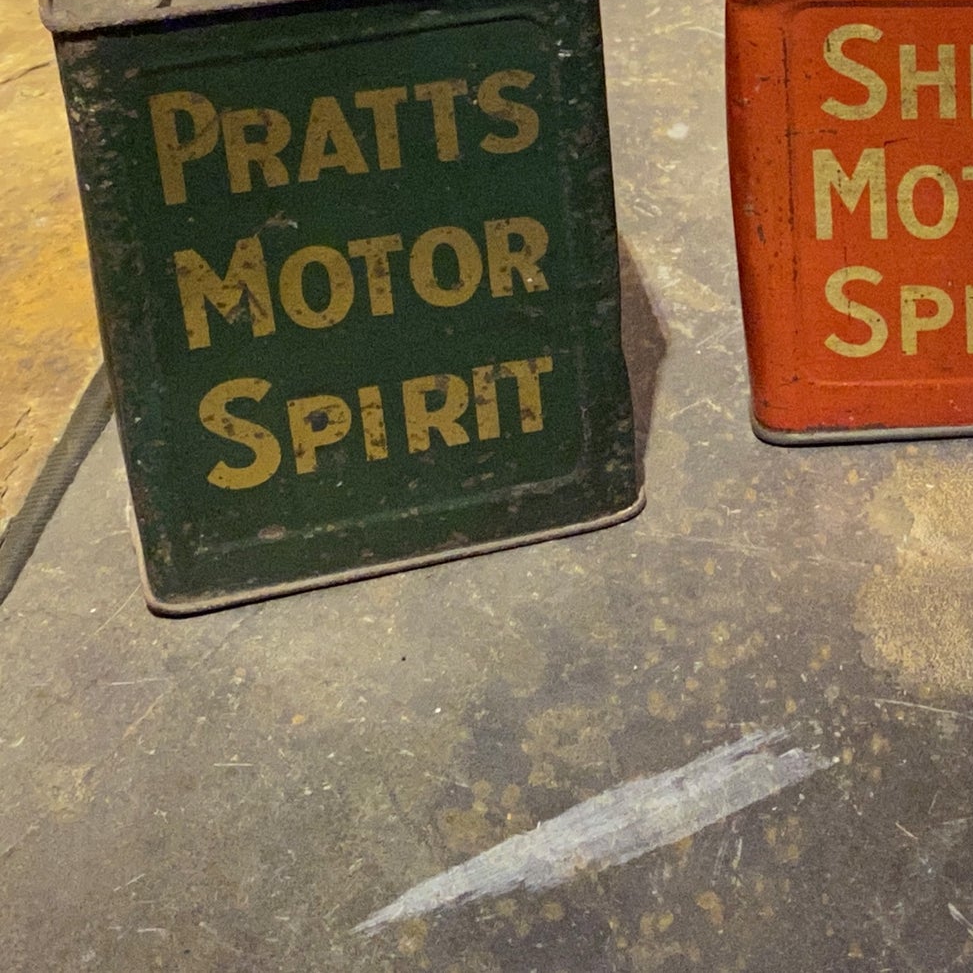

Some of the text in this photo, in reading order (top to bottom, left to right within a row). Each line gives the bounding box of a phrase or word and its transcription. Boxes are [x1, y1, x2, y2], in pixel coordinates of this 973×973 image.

[149, 69, 540, 205] PRATTS
[174, 217, 550, 350] MOTOR
[199, 356, 554, 491] SPIRIT
